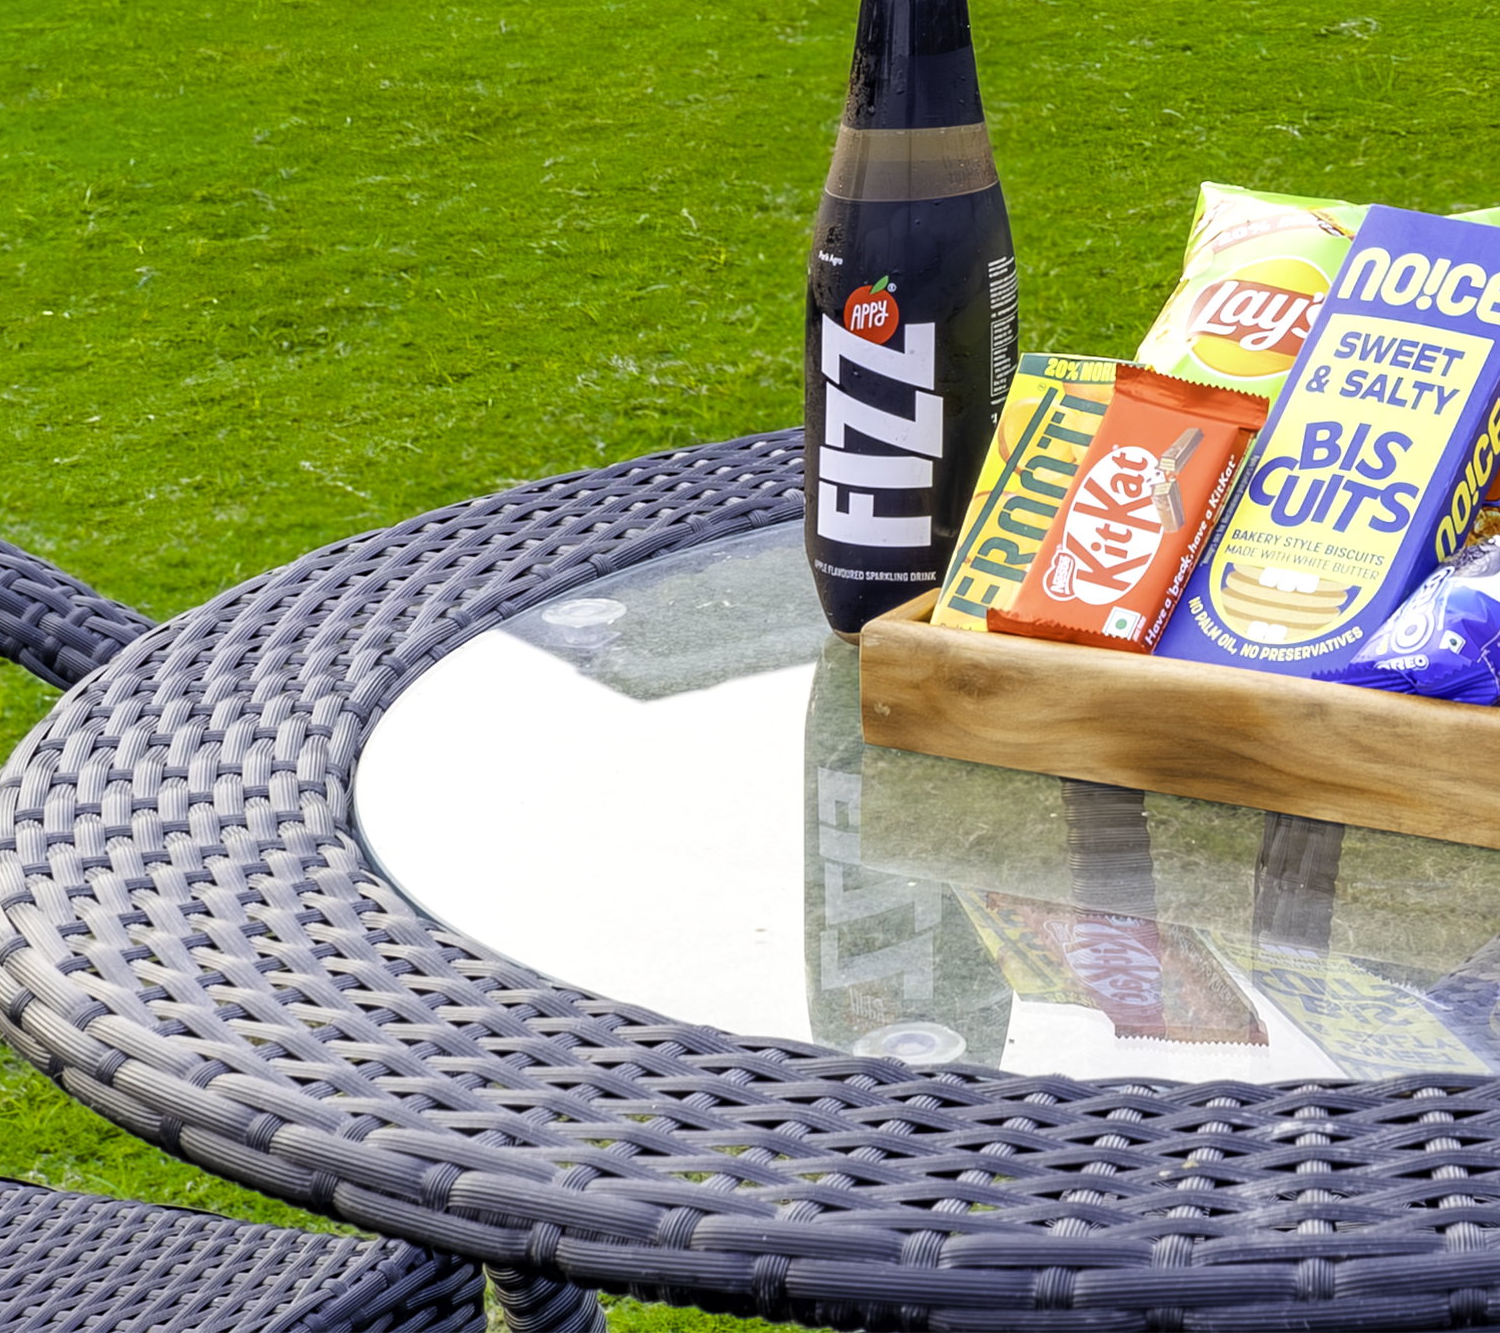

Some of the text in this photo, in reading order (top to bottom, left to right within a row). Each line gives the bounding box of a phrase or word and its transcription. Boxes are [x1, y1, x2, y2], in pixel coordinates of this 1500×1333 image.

[850, 298, 889, 331] APPY
[1044, 357, 1079, 381] 20%
[1333, 331, 1465, 377] SWEET
[1305, 365, 1461, 416] & SALTY
[817, 313, 943, 547] FIZZ
[1298, 421, 1414, 480] BIS
[1248, 455, 1420, 533] CUITS
[1065, 451, 1162, 592] KitKat
[1224, 544, 1379, 582] MADE WITH WHITE BUTTER
[1231, 529, 1385, 566] BAKERY STYLE BISCUITS
[827, 564, 865, 581] FLAVOURED
[865, 571, 909, 582] SPARKLING
[910, 571, 937, 582] DRINK
[1145, 608, 1168, 645] Have
[1164, 599, 1173, 611] a
[1189, 522, 1208, 556] have
[1204, 511, 1213, 522] a
[1188, 596, 1204, 614] NO
[1195, 611, 1219, 642] PALM
[1259, 625, 1364, 662] PRESERVATIVES
[1240, 643, 1260, 660] NO
